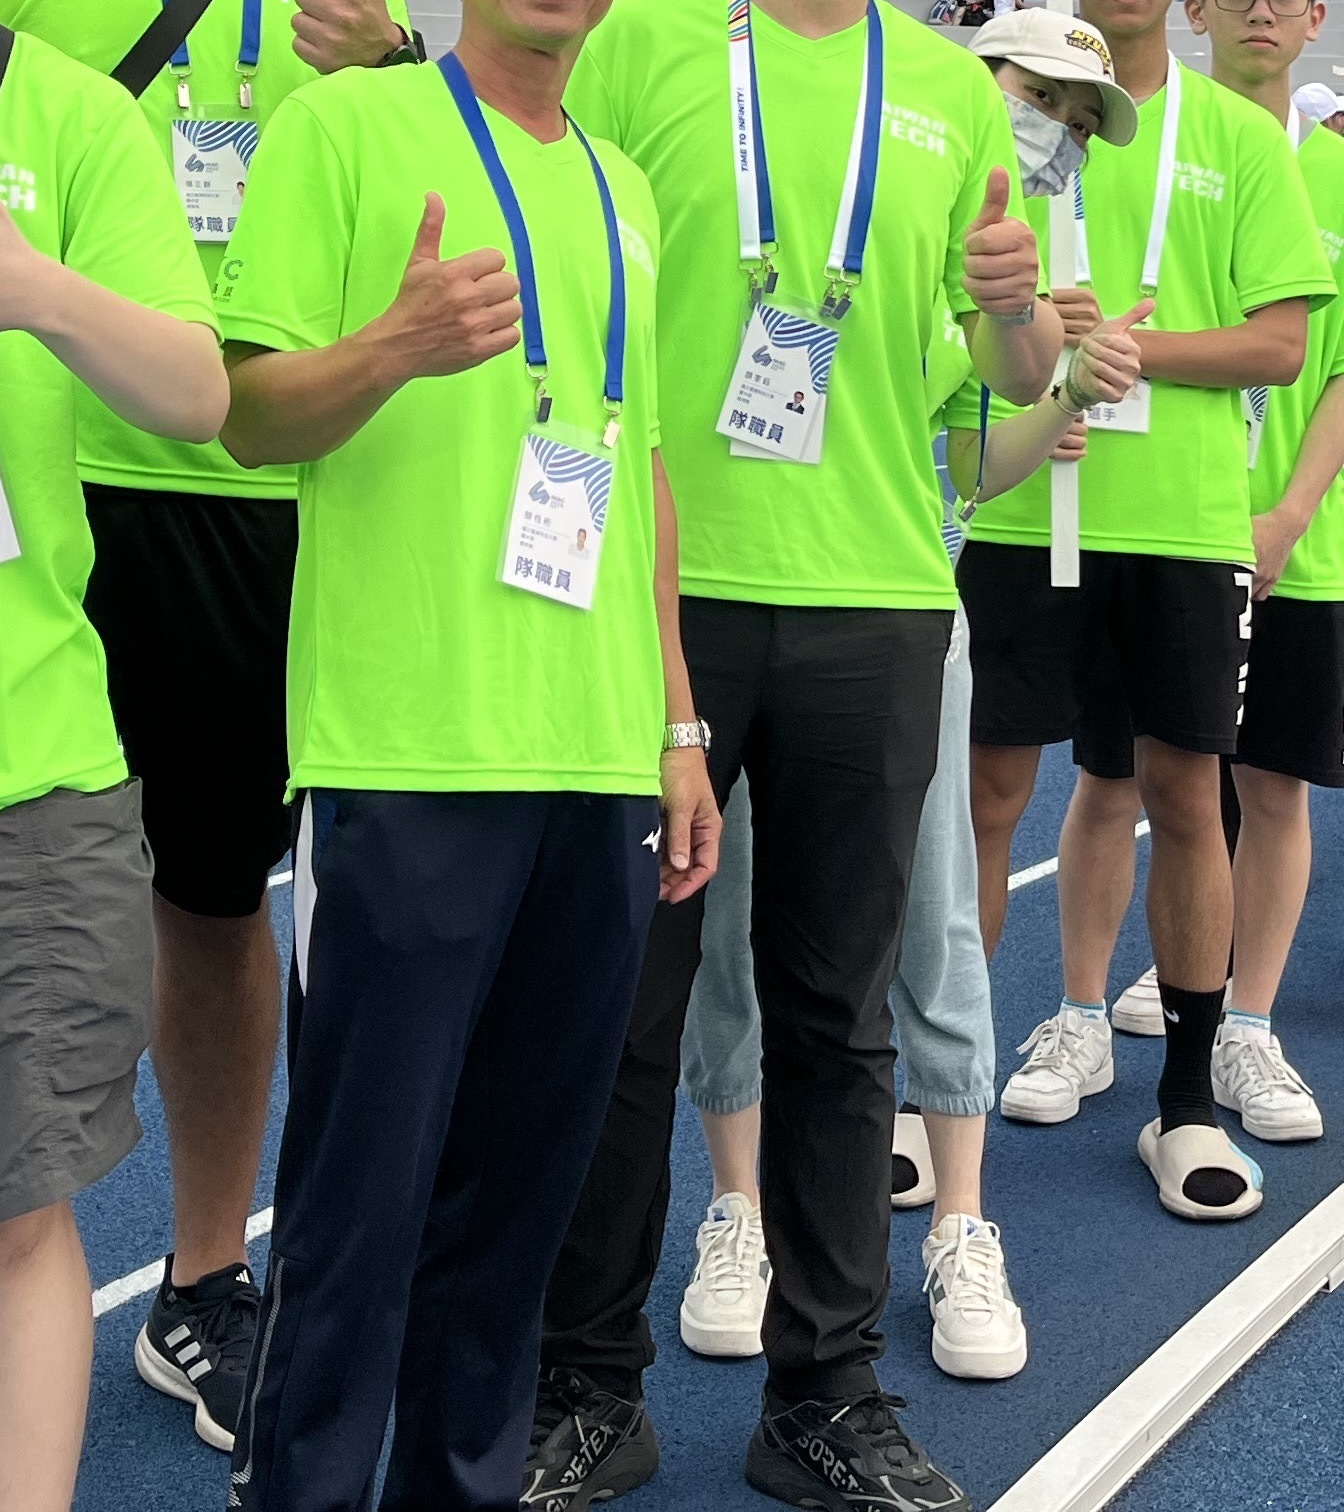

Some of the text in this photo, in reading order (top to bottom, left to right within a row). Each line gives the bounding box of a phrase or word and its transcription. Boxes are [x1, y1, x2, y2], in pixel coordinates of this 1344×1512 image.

[739, 134, 747, 146] TO
[883, 116, 946, 157] ECH
[740, 148, 749, 173] TIME
[728, 409, 785, 444] 隊職員
[514, 555, 571, 593] 隊職員
